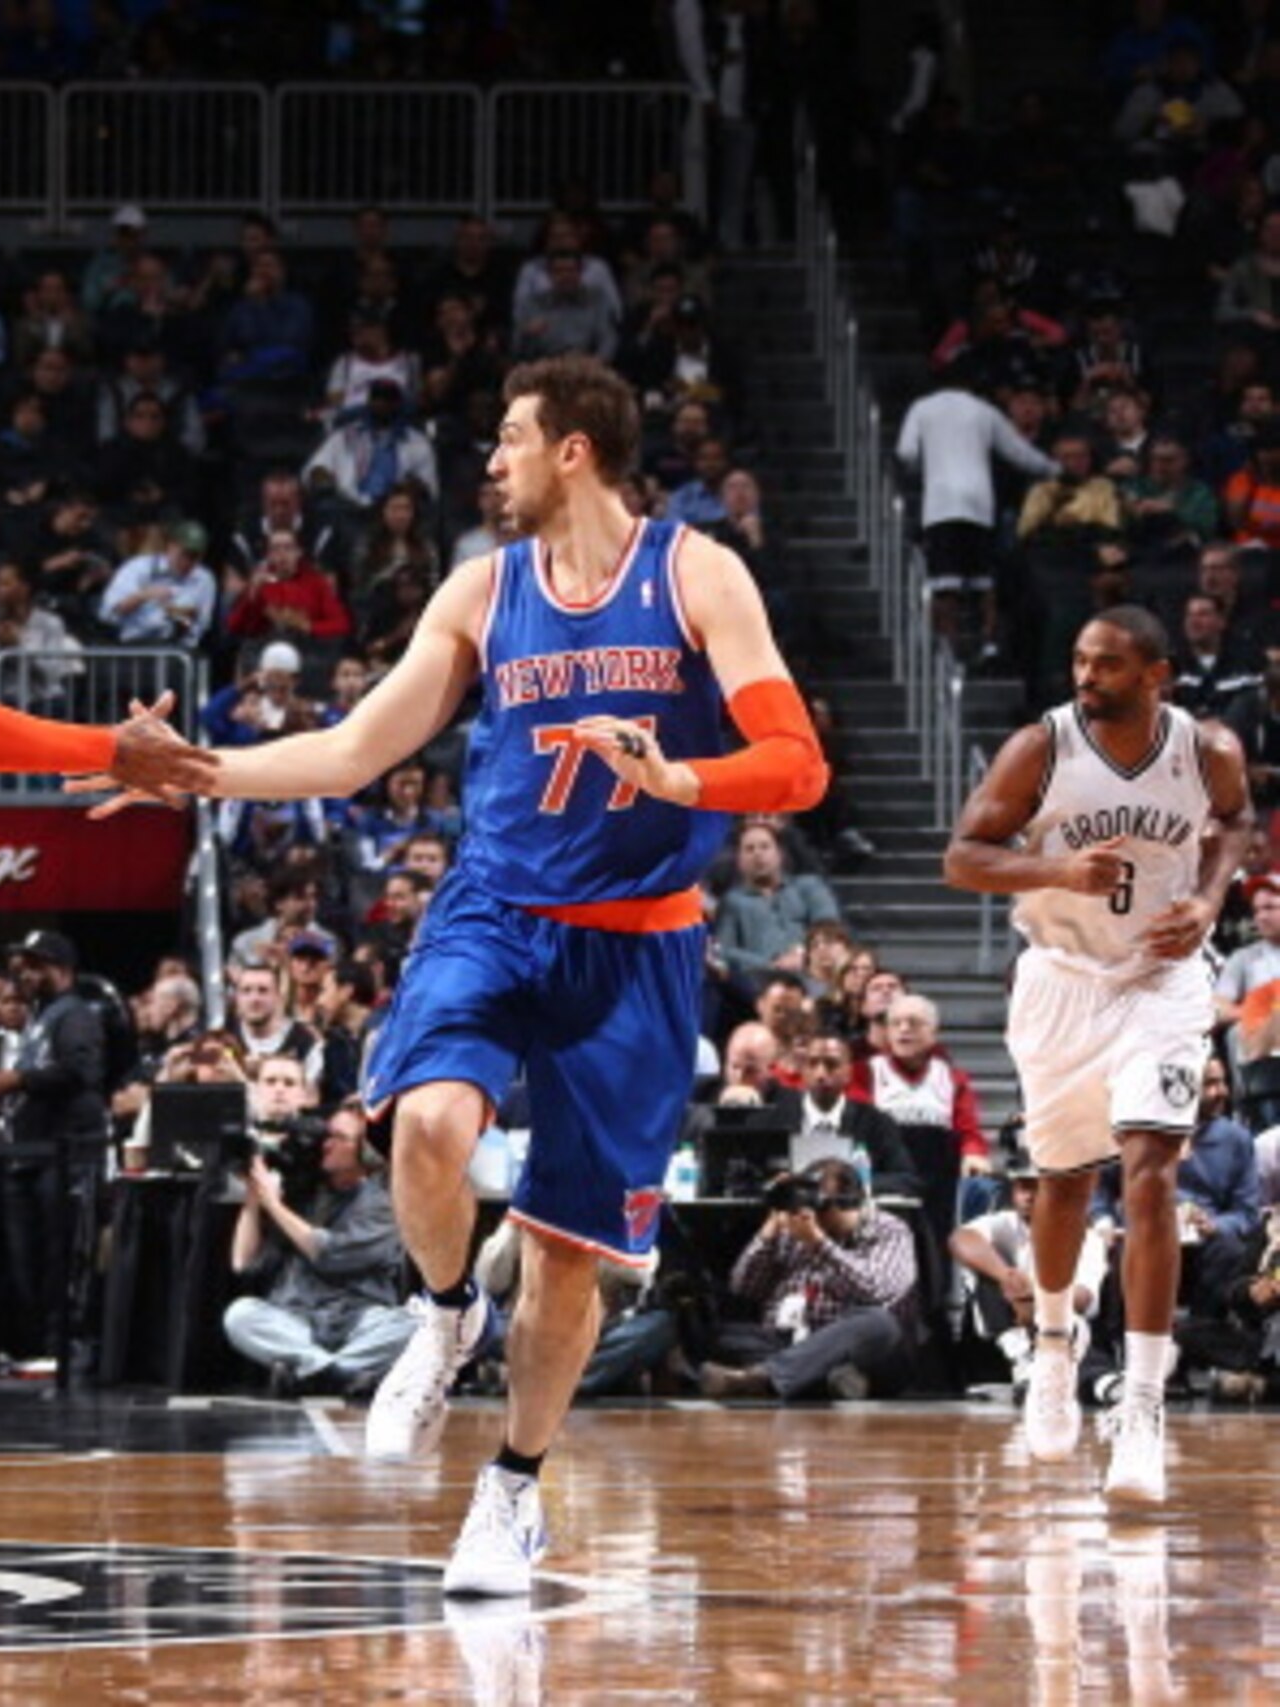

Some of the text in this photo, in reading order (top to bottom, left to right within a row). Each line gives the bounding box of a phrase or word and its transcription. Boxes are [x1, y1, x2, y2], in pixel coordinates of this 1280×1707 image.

[494, 645, 687, 711] NEW YORK
[1059, 805, 1193, 850] BROOKLYN
